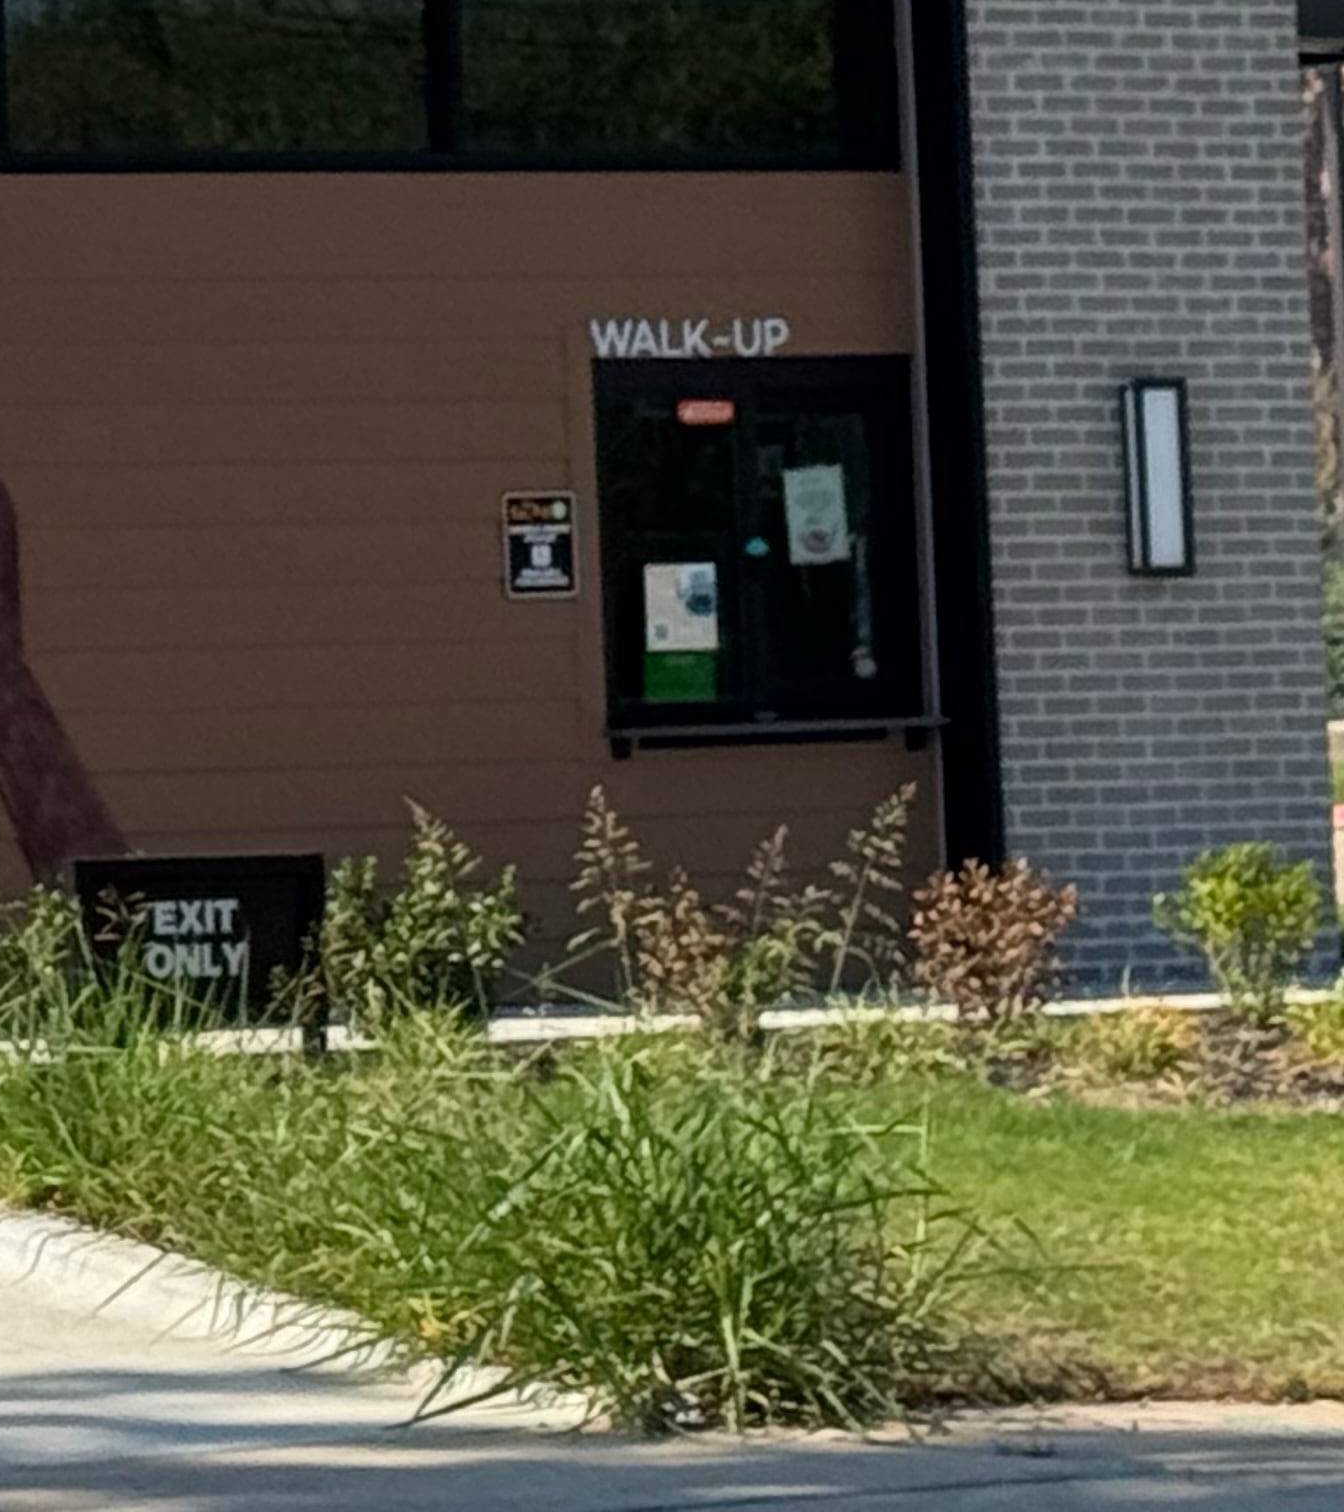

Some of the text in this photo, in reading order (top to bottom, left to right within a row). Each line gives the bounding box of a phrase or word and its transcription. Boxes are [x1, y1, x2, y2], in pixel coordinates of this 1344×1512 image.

[590, 317, 791, 358] WALK-UP
[151, 898, 239, 935] EXIT
[145, 941, 248, 978] ONLY
